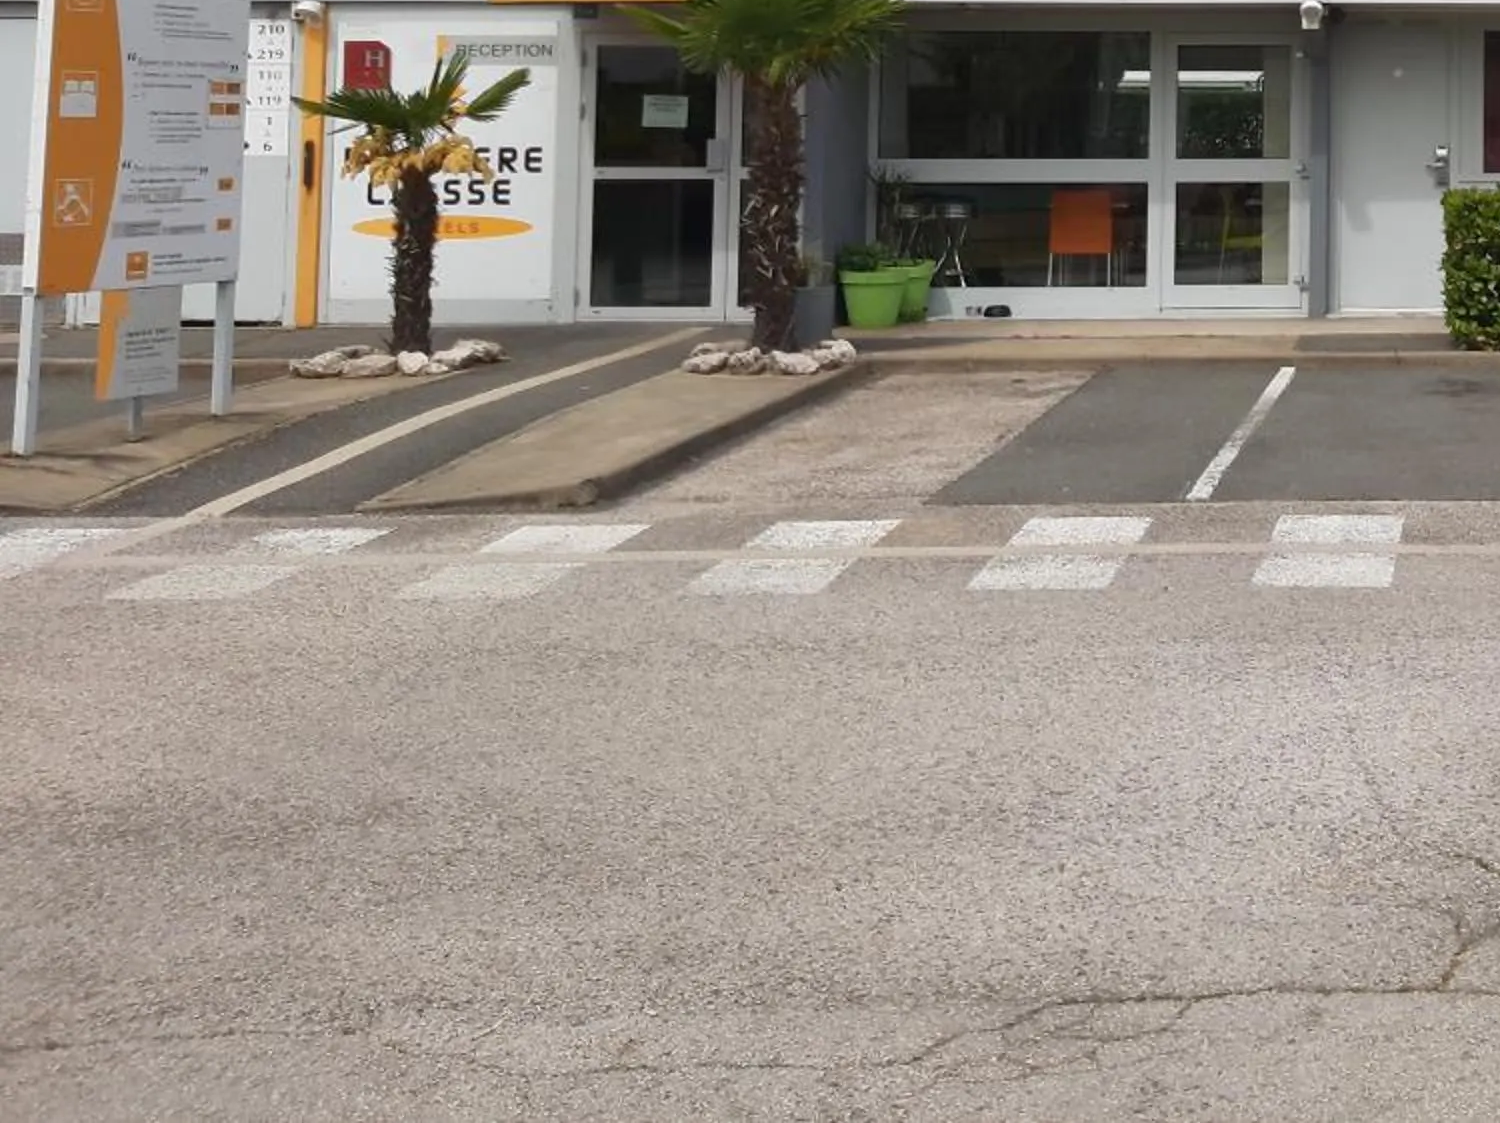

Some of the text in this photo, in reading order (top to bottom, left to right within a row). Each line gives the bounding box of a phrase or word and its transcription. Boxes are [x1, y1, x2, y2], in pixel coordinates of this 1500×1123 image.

[257, 24, 285, 35] 210
[257, 49, 284, 60] 219
[455, 43, 553, 58] RECEPTION
[365, 50, 385, 68] H
[258, 95, 282, 107] 119
